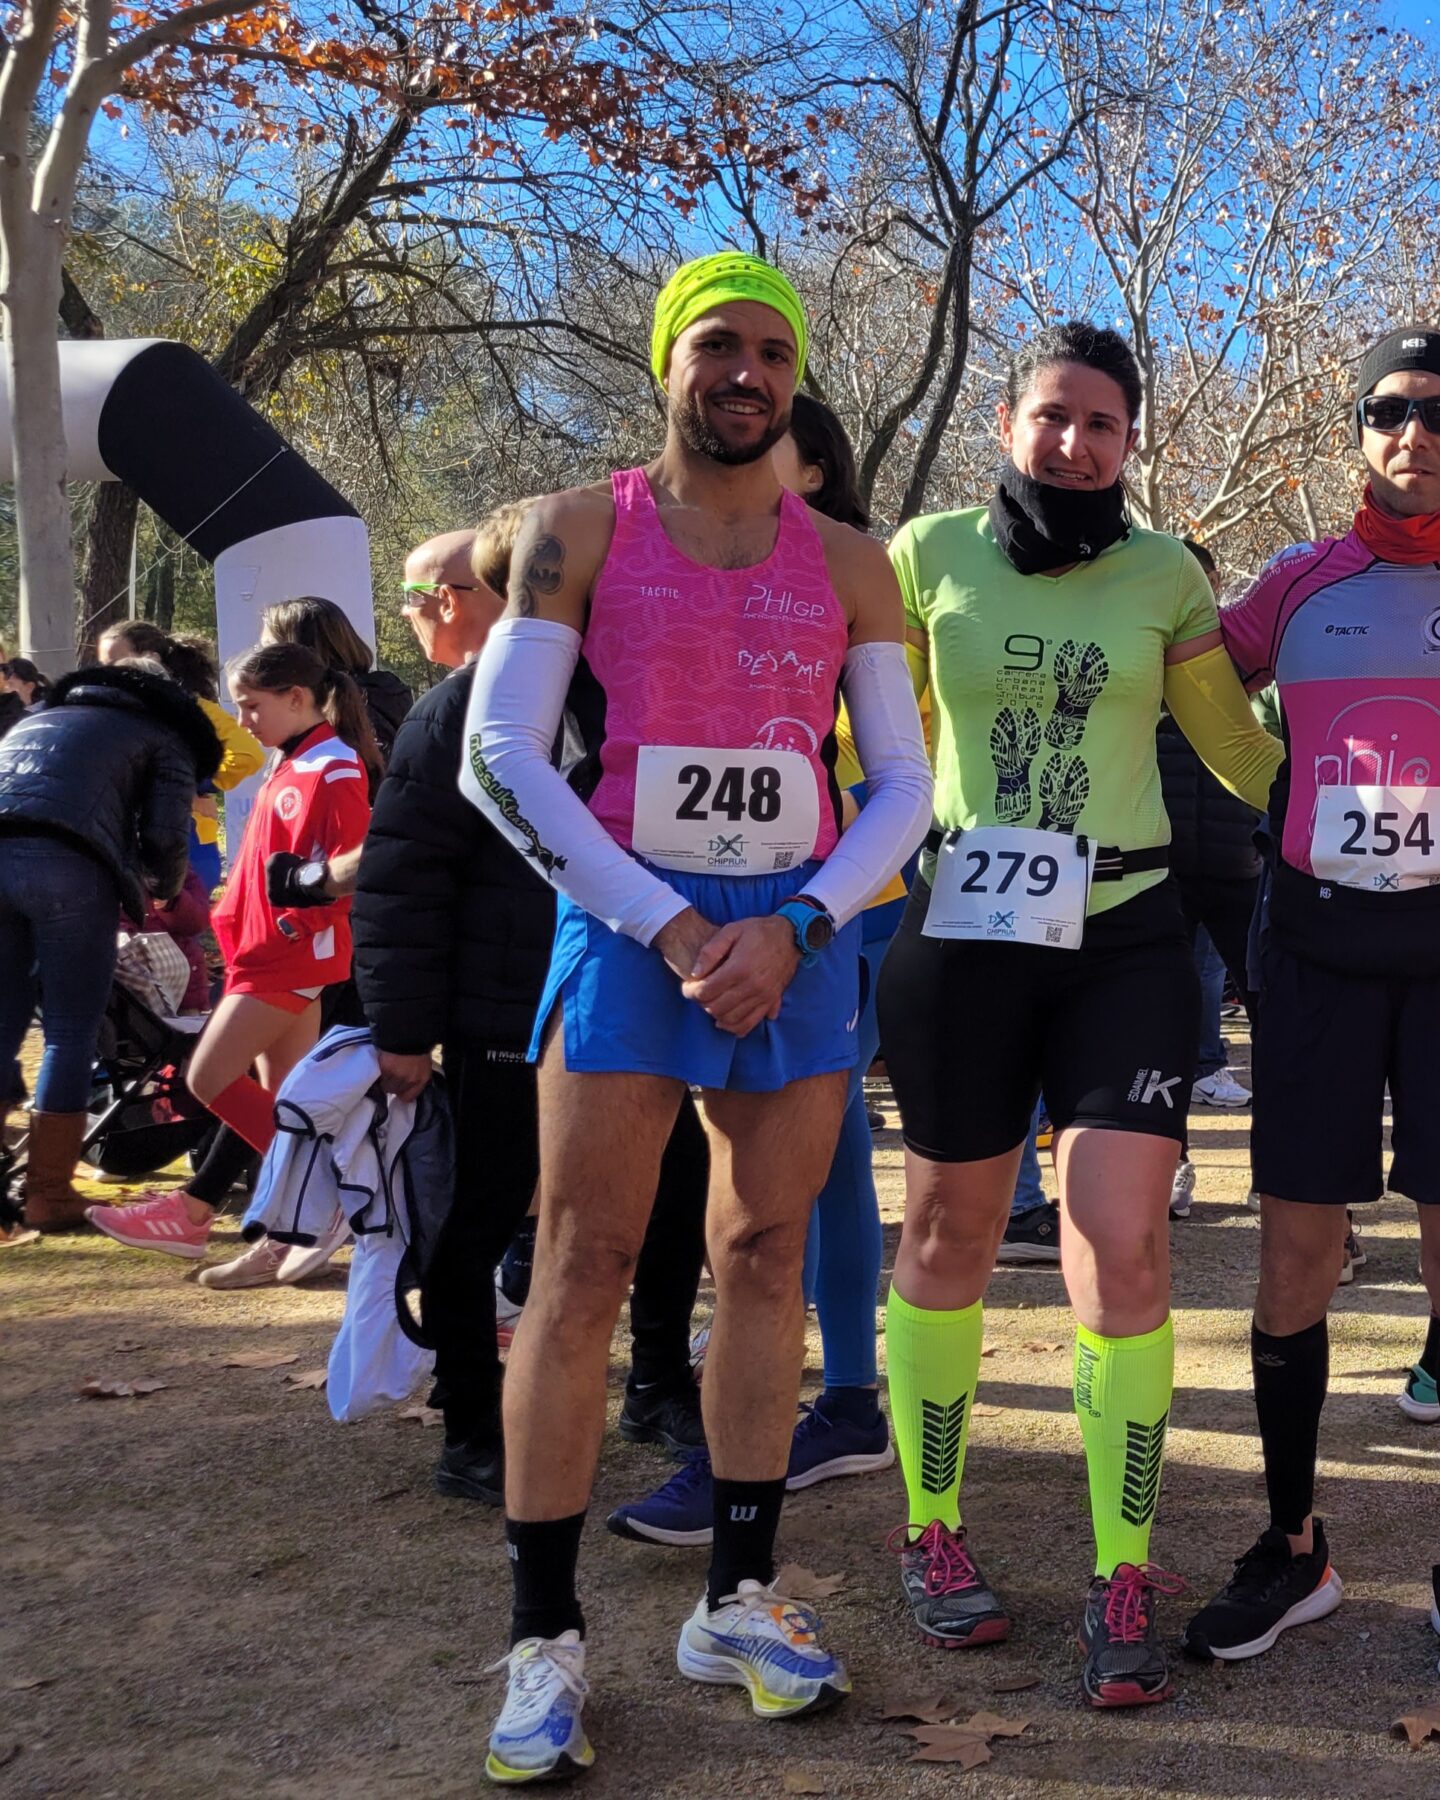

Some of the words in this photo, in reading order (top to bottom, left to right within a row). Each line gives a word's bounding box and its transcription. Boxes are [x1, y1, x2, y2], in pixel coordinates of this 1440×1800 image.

[640, 586, 680, 599] TACTIC
[1335, 625, 1370, 636] TACTIC
[997, 669, 1046, 679] carrera
[997, 677, 1045, 686] urbana
[675, 764, 781, 822] 248
[1340, 810, 1435, 857] 254
[707, 856, 748, 865] CHIPRUN
[960, 850, 1059, 897] 279
